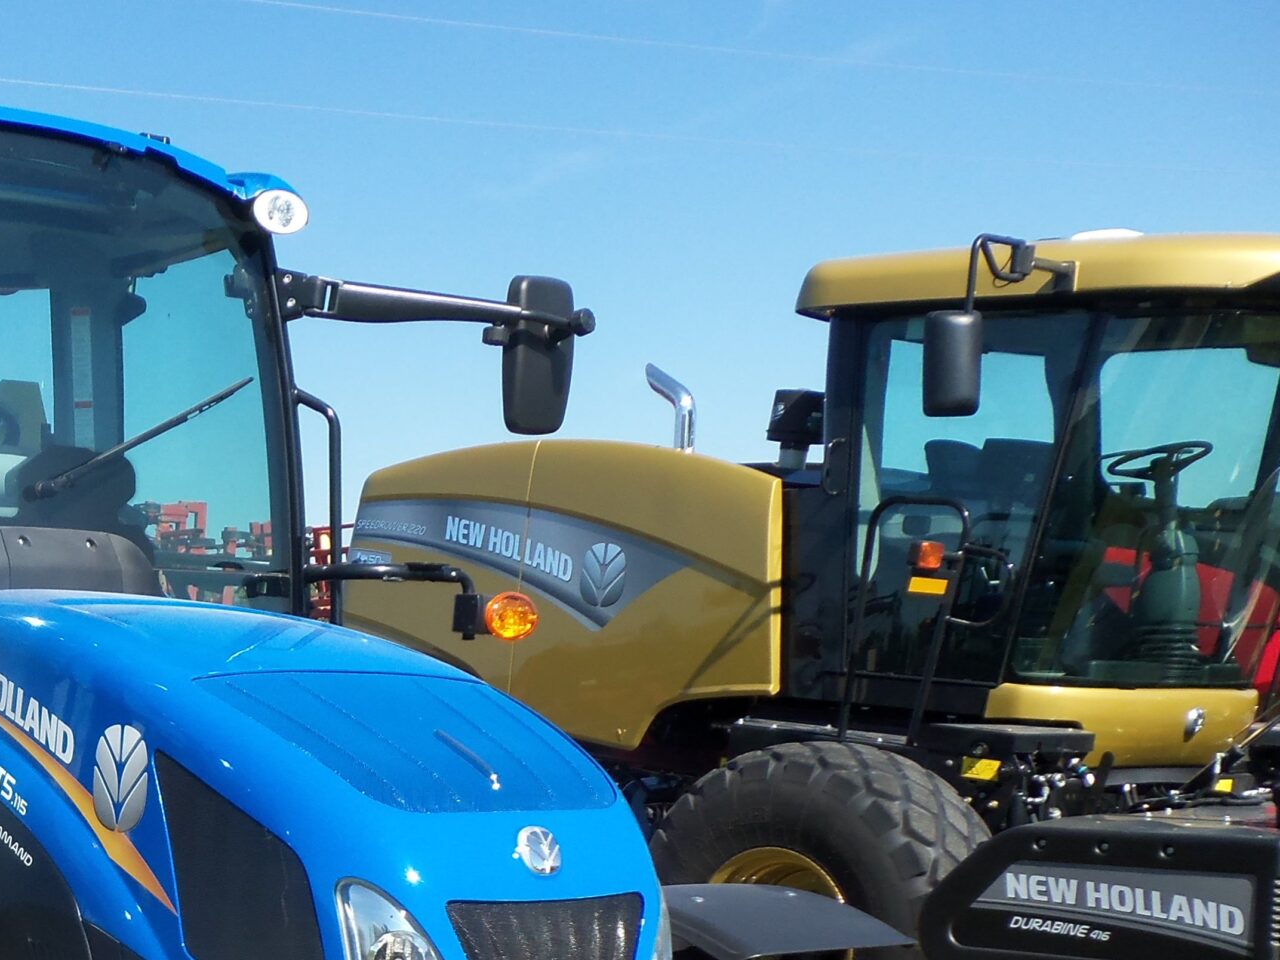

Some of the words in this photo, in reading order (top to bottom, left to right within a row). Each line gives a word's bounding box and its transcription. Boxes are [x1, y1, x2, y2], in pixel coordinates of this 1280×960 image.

[356, 519, 408, 533] SPEEDROWER
[407, 523, 427, 536] 220
[445, 515, 486, 549] NEW
[488, 526, 573, 583] HOLLAND
[1005, 872, 1078, 905] NEW
[1086, 880, 1246, 936] HOLLAND
[1009, 916, 1090, 938] DURABINE
[1090, 929, 1112, 942] 416
